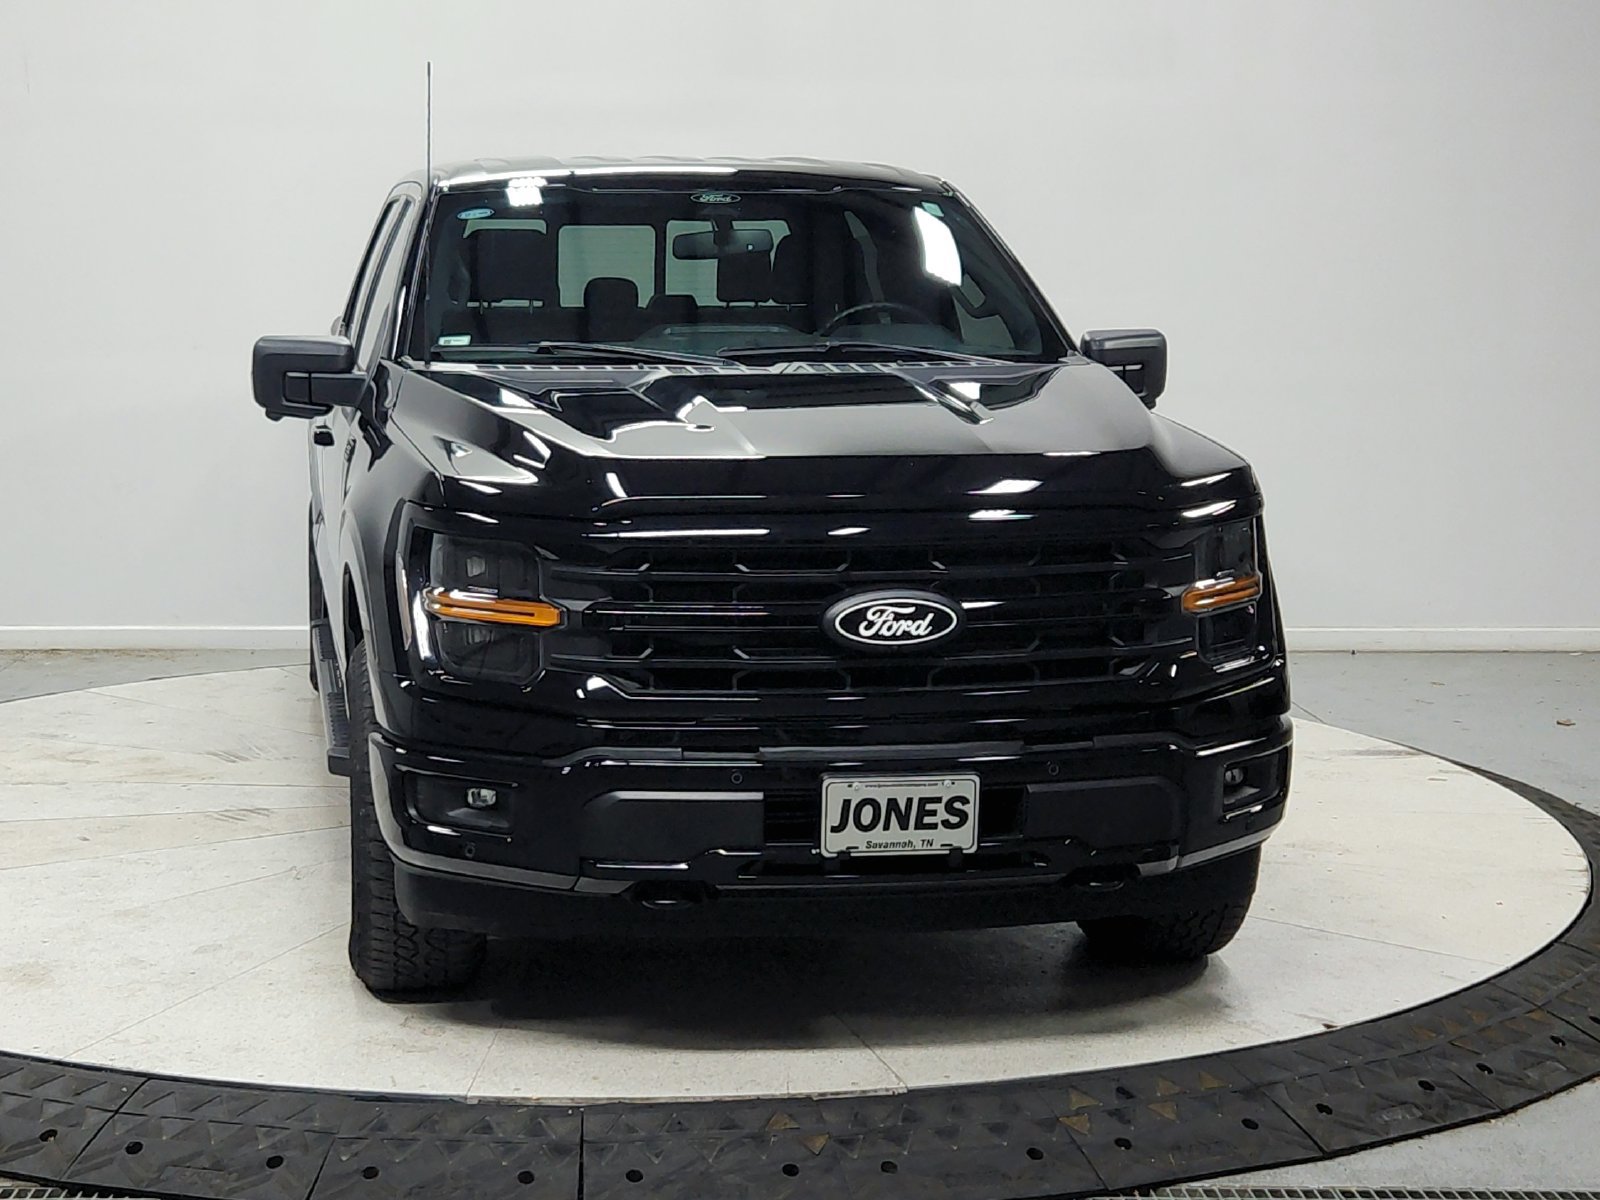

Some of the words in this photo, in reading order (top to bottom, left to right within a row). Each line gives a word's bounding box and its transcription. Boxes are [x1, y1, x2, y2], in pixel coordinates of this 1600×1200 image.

[859, 605, 934, 637] Ford
[830, 795, 971, 834] JONES
[865, 839, 916, 849] Savannah,
[920, 838, 934, 848] TN
